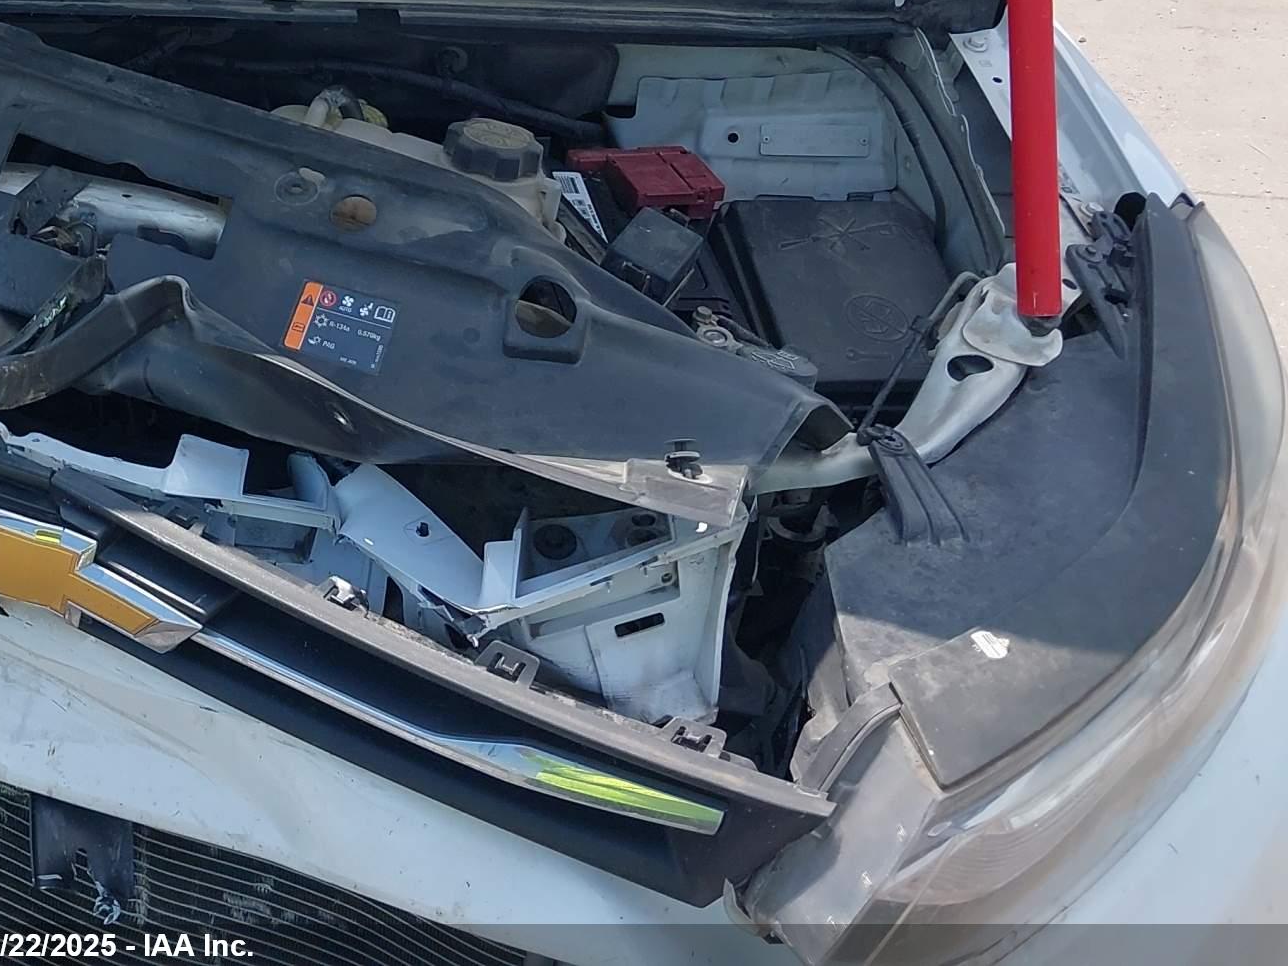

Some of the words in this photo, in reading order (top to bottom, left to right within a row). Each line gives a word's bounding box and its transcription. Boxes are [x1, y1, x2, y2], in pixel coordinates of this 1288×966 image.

[339, 305, 352, 313] AUTO
[329, 321, 350, 332] R-134a
[322, 340, 335, 349] PAG
